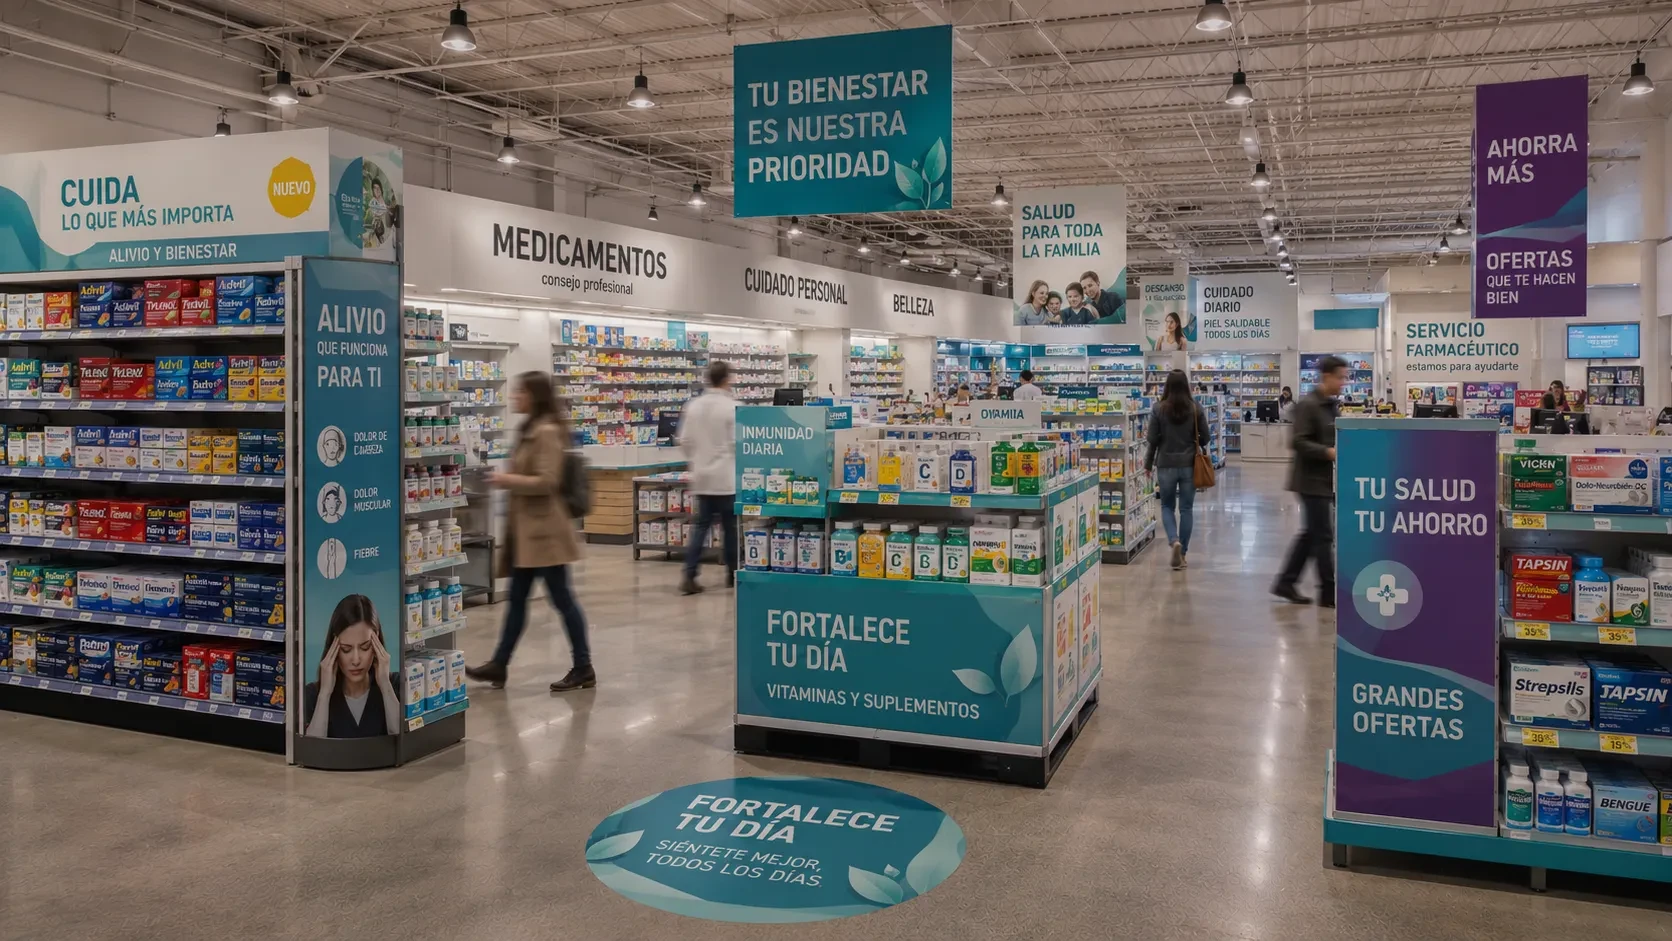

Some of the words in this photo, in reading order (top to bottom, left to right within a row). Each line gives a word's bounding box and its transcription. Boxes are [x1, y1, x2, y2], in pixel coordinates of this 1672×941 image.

[748, 81, 779, 107] TU
[788, 69, 928, 105] BIENESTAR
[749, 118, 778, 145] ES
[787, 110, 907, 142] NUESTRA
[1487, 133, 1578, 158] AHORRA
[748, 150, 889, 183] PRIORIDAD
[1487, 159, 1535, 185] MÁS
[61, 175, 140, 207] CUIDA
[273, 181, 310, 197] NUEVO
[62, 213, 80, 231] LO
[85, 211, 117, 231] QUE
[122, 204, 157, 228] MÁS
[162, 204, 234, 225] IMPORTA
[1022, 203, 1075, 220] SALUD
[1022, 224, 1060, 239] PARA
[1064, 223, 1103, 238] TODA
[109, 246, 150, 262] ALIVIO
[153, 247, 161, 260] Y
[166, 243, 237, 260] BIENESTAR
[493, 222, 667, 280] MEDICAMENTOS
[1022, 245, 1040, 258] LA
[1044, 242, 1100, 257] FAMILIA
[1486, 249, 1573, 270] OFERTAS
[541, 274, 581, 293] consejo
[583, 278, 633, 296] profesional
[744, 267, 795, 298] CUIDADO
[798, 277, 848, 305] PERSONAL
[1486, 275, 1511, 288] QUE
[1515, 274, 1530, 286] TE
[1533, 272, 1576, 286] HACEN
[1204, 286, 1254, 298] CUIDADO
[1486, 290, 1519, 304] BIEN
[893, 293, 935, 317] BELLEZA
[1204, 301, 1241, 313] DIARIO
[317, 304, 386, 335] ALIVIO
[1204, 319, 1221, 328] PIEL
[1204, 330, 1231, 339] TODOS
[1233, 330, 1248, 339] LOS
[1251, 329, 1270, 338] DÍAS
[1406, 322, 1485, 338] SERVICIO
[317, 341, 337, 356] QUE
[340, 342, 388, 357] FUNCIONA
[1406, 340, 1519, 357] FARMACÉUTICO
[317, 365, 363, 388] PARA
[368, 366, 381, 388] TI
[1406, 363, 1447, 371] estamos
[1450, 364, 1471, 374] para
[1474, 362, 1519, 373] ayudarte
[354, 432, 377, 442] DOLOR
[379, 431, 388, 440] DE
[742, 426, 813, 440] INMUNIDAD
[742, 443, 784, 456] DIARIA
[919, 463, 930, 479] C
[955, 469, 965, 480] D
[354, 487, 378, 499] DOLOR
[1354, 477, 1386, 500] TU
[1394, 477, 1476, 502] SALUD
[354, 499, 392, 512] MUSCULAR
[1354, 510, 1385, 533] TU
[1392, 511, 1488, 536] AHORRO
[354, 546, 379, 559] FIEBRE
[920, 554, 930, 569] B
[1517, 558, 1568, 571] TAPSIN
[767, 609, 910, 645] FORTALECE
[767, 641, 797, 668] TU
[806, 641, 848, 673] DÍA
[1515, 678, 1585, 696] Strepsils
[767, 682, 846, 706] VITAMINAS
[850, 691, 860, 706] Y
[864, 693, 980, 720] SUPLEMENTOS
[1352, 682, 1464, 711] GRANDES
[1352, 711, 1464, 740] OFERTAS
[687, 794, 900, 832] FORTALECE
[1600, 798, 1651, 812] BENGUE
[676, 813, 724, 833] TU
[730, 819, 796, 844] DÍA
[656, 839, 748, 862] SIÉNTETE
[750, 851, 822, 873] MEJOR,
[646, 853, 714, 872] TODOS
[719, 863, 762, 879] LOS
